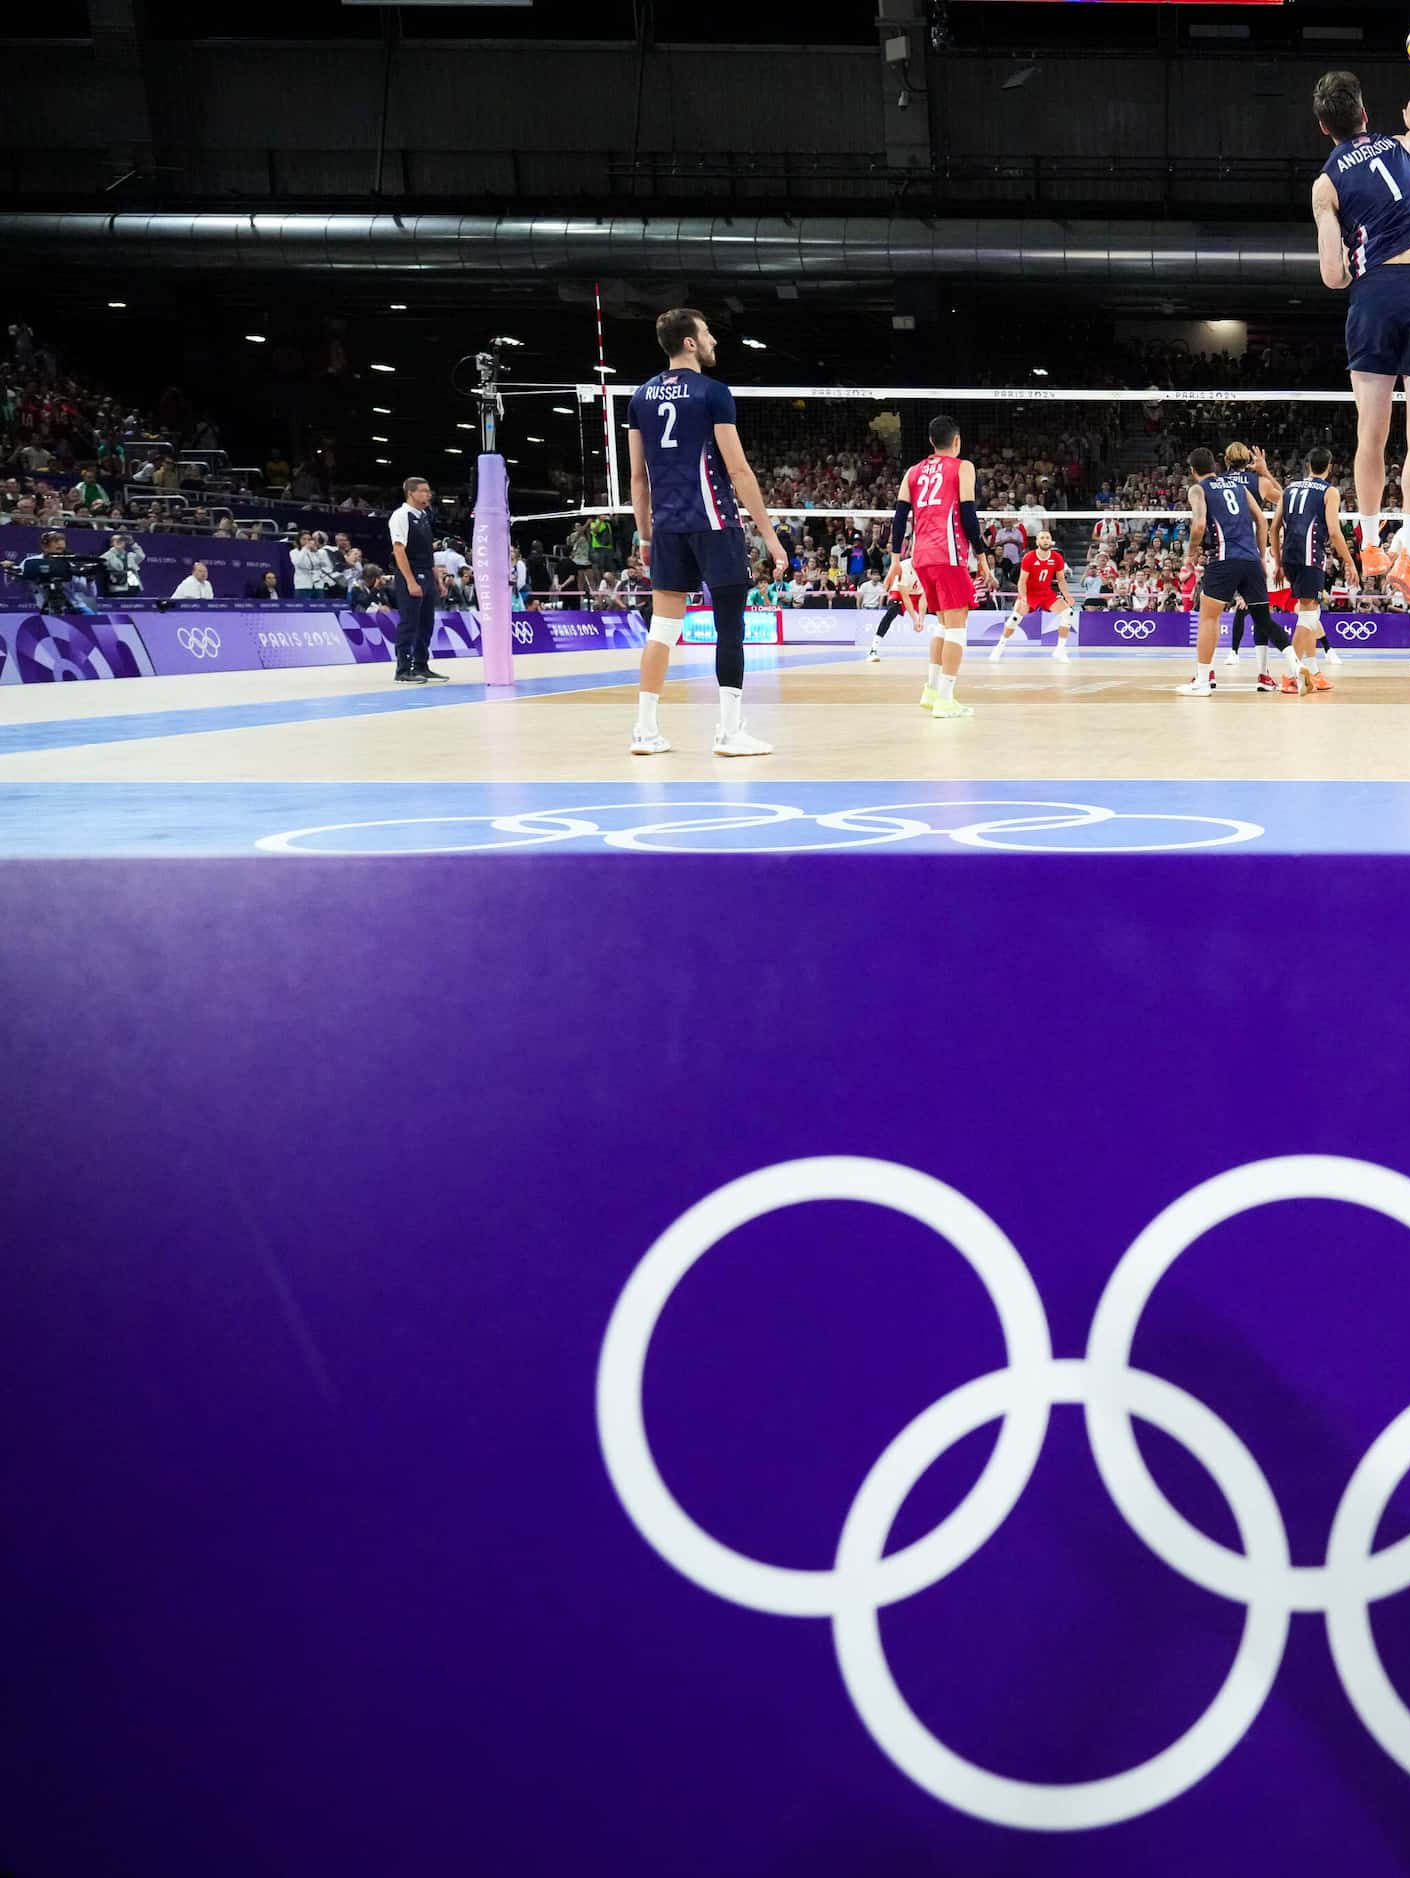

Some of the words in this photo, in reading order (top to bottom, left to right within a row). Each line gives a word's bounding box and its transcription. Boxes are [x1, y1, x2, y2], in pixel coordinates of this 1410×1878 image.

[1337, 137, 1397, 173] ANDERSON
[1369, 157, 1402, 201] 1
[645, 384, 690, 400] RUSSELL
[657, 402, 678, 448] 2
[916, 473, 943, 508] 22
[1222, 489, 1240, 515] 8
[1288, 488, 1309, 514] 11
[477, 524, 489, 568] 2024
[478, 575, 491, 622] PARIS
[259, 632, 302, 648] PARIS
[304, 631, 341, 647] 2024
[552, 624, 577, 637] PARIS
[577, 623, 600, 636] 2024
